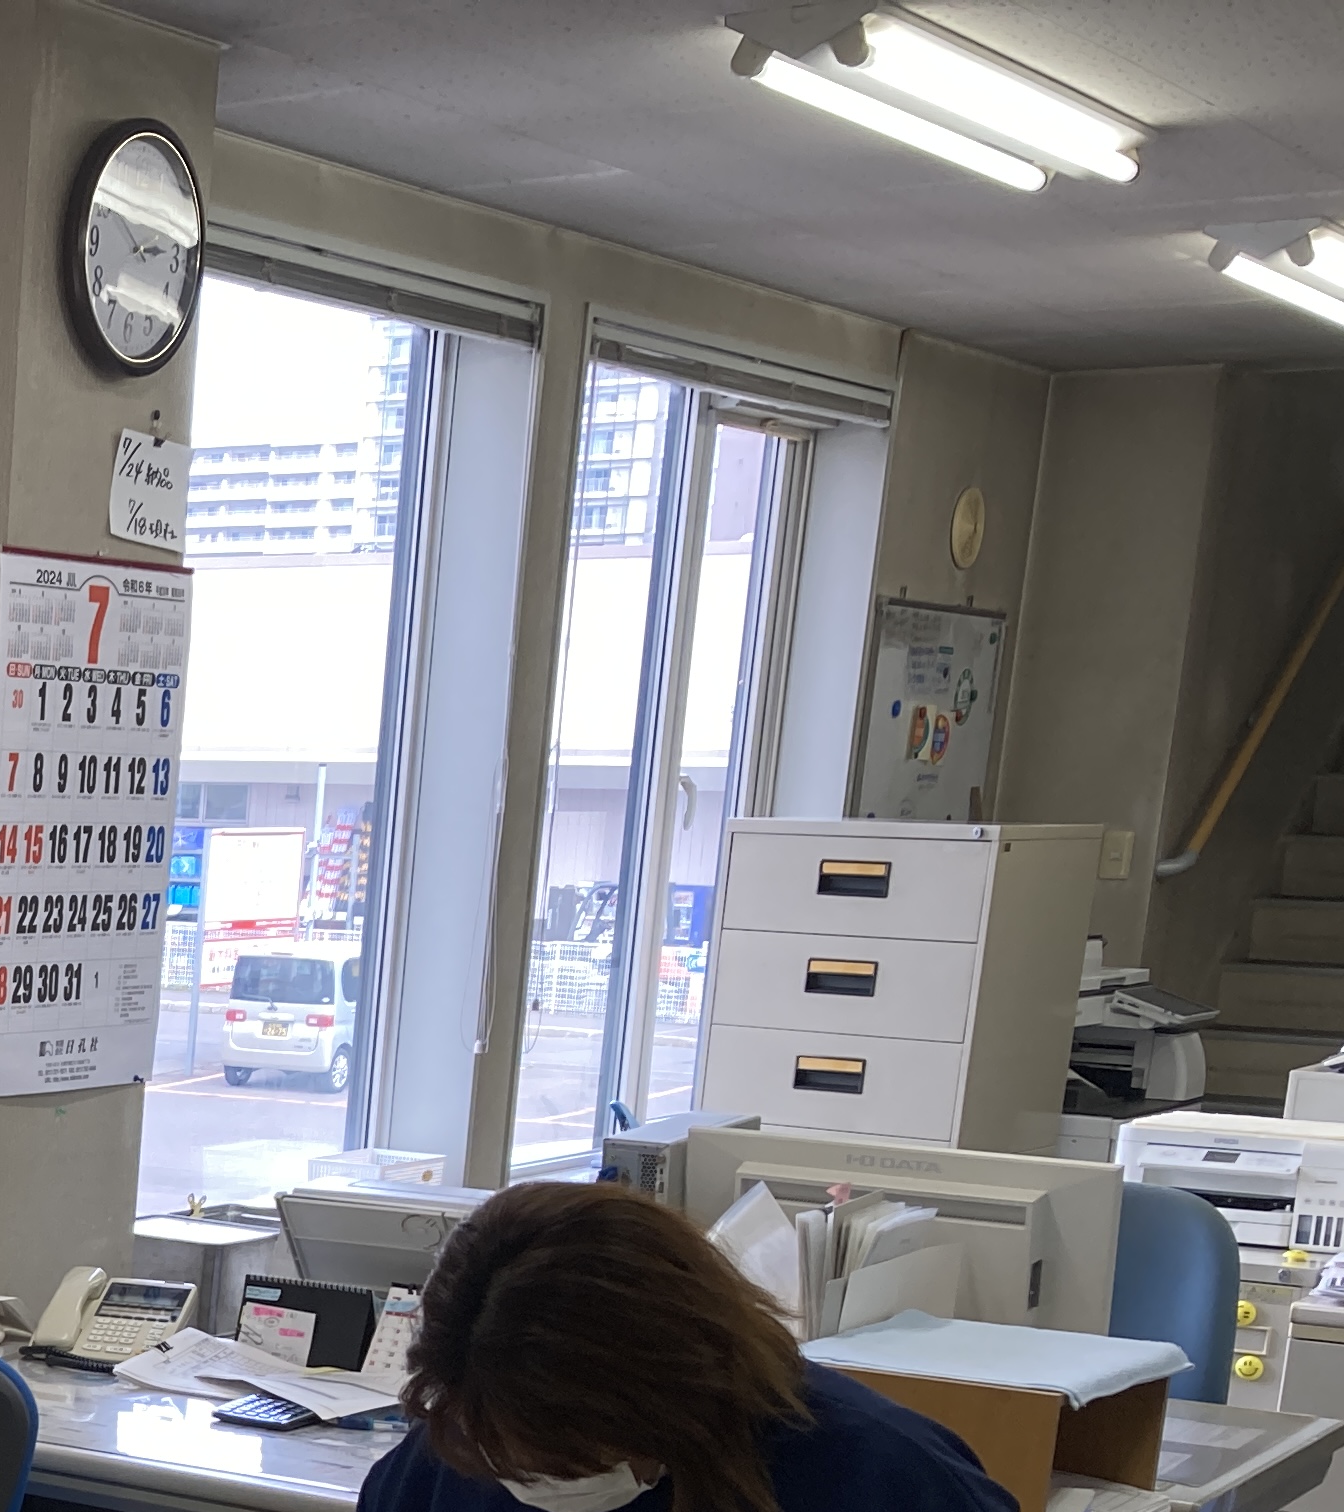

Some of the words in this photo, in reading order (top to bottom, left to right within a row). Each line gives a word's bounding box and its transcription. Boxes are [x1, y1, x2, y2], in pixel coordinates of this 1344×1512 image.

[90, 225, 100, 257] 9
[170, 244, 180, 274] 3
[92, 266, 102, 297] 8
[106, 300, 116, 328] 7
[124, 312, 134, 343] 6
[36, 569, 62, 586] 2024
[122, 578, 152, 595] 令和6年
[88, 585, 110, 664] 7
[12, 689, 24, 708] 30
[39, 682, 46, 720] 1
[62, 683, 73, 722] 2
[87, 684, 98, 724] 3
[111, 687, 122, 724] 4
[136, 688, 147, 726] 5
[160, 690, 171, 728] 6
[8, 752, 19, 792] 7
[33, 752, 44, 792] 8
[58, 754, 68, 793] 9
[79, 755, 98, 794] 10
[104, 756, 122, 794] 11
[128, 757, 146, 794] 12
[152, 758, 170, 796] 13
[24, 825, 44, 864] 15
[49, 824, 68, 863] 16
[73, 826, 93, 863] 17
[98, 825, 118, 863] 18
[123, 825, 142, 863] 19
[145, 826, 165, 863] 20
[16, 895, 39, 934] 22
[42, 895, 64, 933] 23
[67, 894, 88, 932] 24
[90, 894, 114, 932] 25
[116, 893, 138, 930] 26
[141, 893, 160, 930] 27
[12, 965, 34, 1004] 29
[38, 964, 59, 1002] 30
[64, 963, 82, 1001] 31
[94, 972, 98, 988] 1
[880, 1158, 943, 1174] DATA
